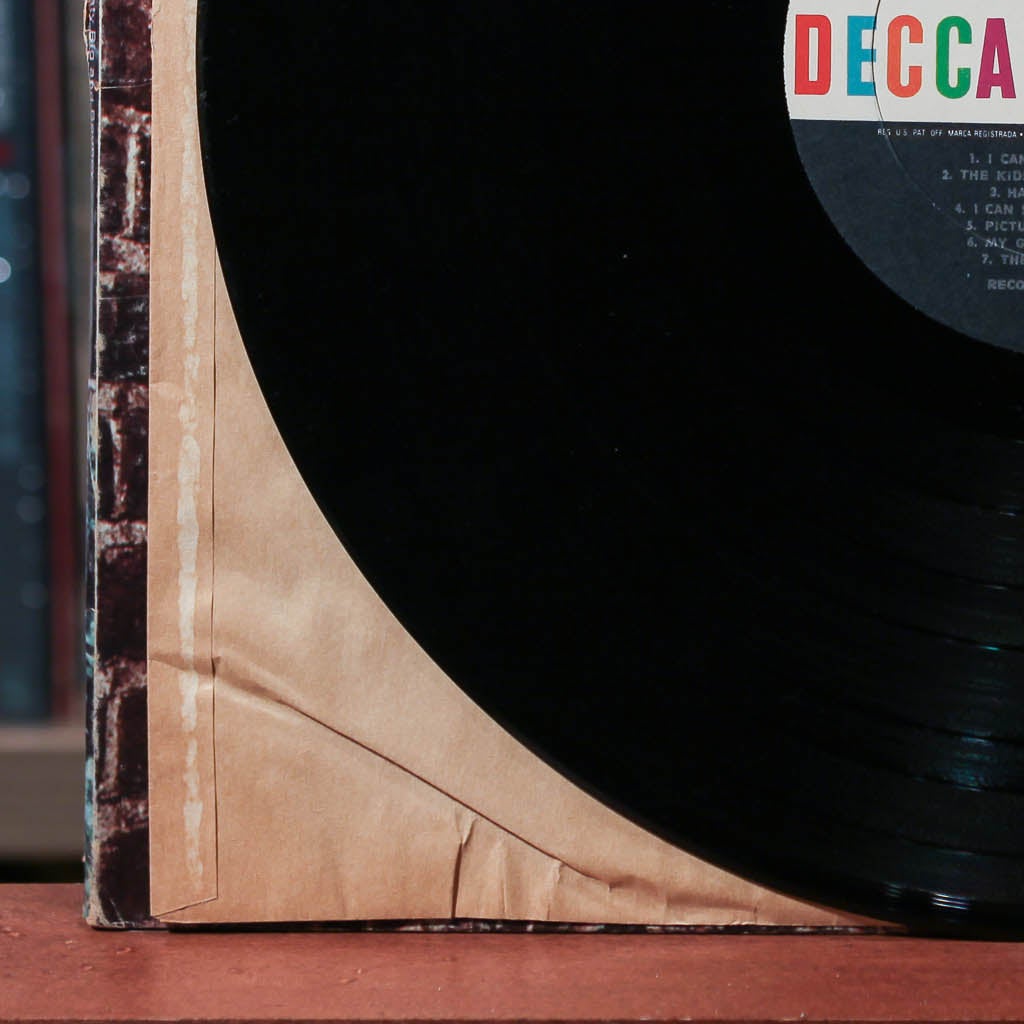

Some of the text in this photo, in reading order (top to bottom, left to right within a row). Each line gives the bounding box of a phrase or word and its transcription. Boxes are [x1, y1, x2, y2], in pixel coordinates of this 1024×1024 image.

[794, 14, 1017, 99] DECCA
[947, 129, 972, 137] MARCA
[974, 130, 1017, 138] REGISTRADA
[969, 153, 980, 164] 1.
[942, 170, 952, 181] 2.
[960, 169, 989, 181] THE
[955, 203, 965, 214] 4.
[985, 204, 1014, 215] CAN
[966, 220, 976, 231] 5.
[966, 238, 977, 248] 6.
[985, 238, 1006, 249] MY
[981, 254, 992, 265] 7.
